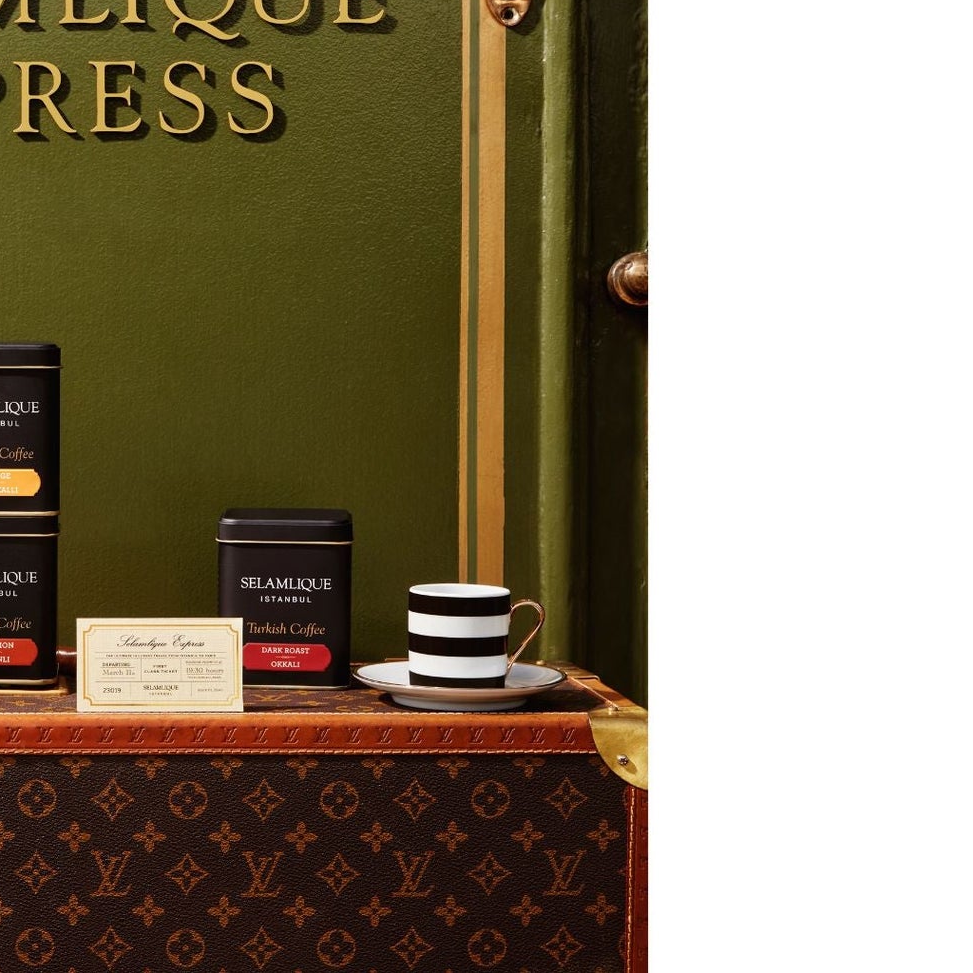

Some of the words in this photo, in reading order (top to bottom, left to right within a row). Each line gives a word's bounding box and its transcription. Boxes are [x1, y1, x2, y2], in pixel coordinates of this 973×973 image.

[240, 577, 332, 593] SELAMLIQUE
[260, 595, 311, 603] ISTANBUL
[246, 622, 287, 635] Turkish
[289, 622, 326, 638] Coffee
[117, 634, 168, 651] Selamlique
[172, 634, 206, 651] Express
[261, 646, 283, 654] DARK
[270, 660, 300, 668] OKKALI
